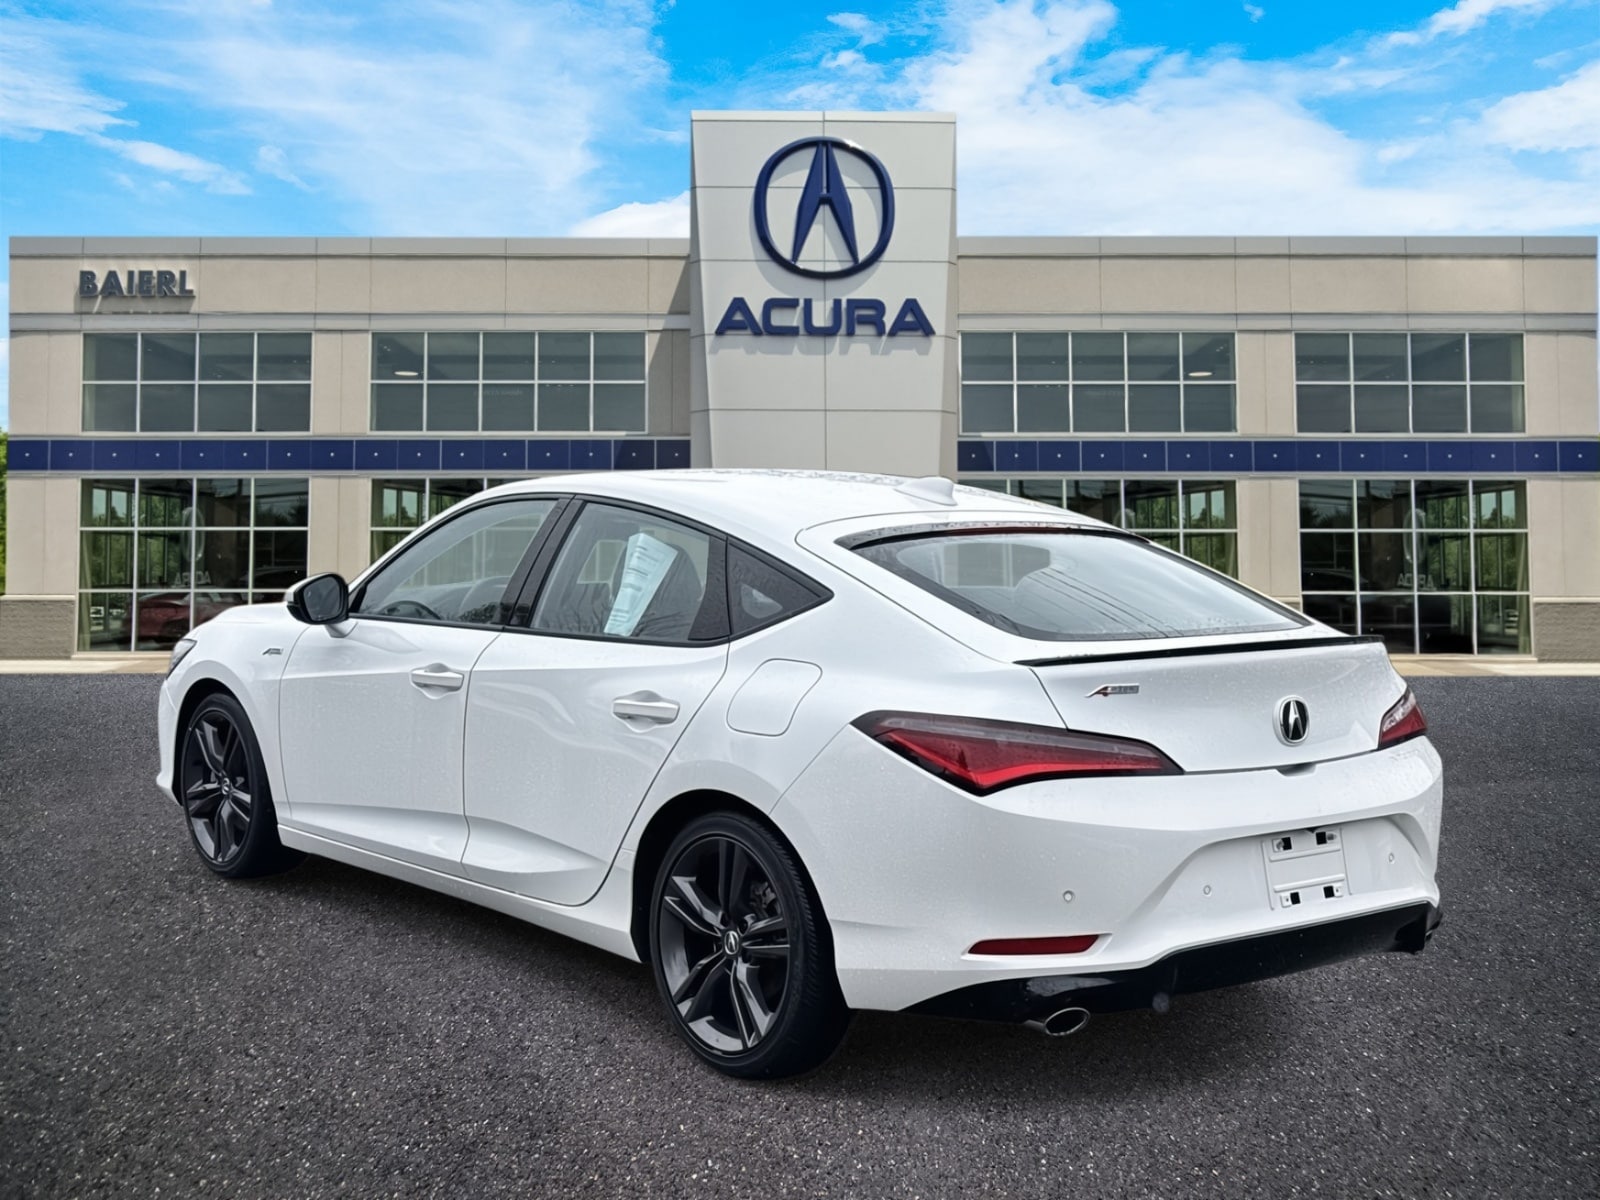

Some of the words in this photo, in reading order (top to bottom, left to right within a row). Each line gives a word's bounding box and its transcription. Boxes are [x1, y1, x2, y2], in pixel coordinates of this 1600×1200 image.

[79, 270, 194, 296] BAIERL
[715, 297, 936, 336] ACURA
[1397, 573, 1434, 588] ACRA
